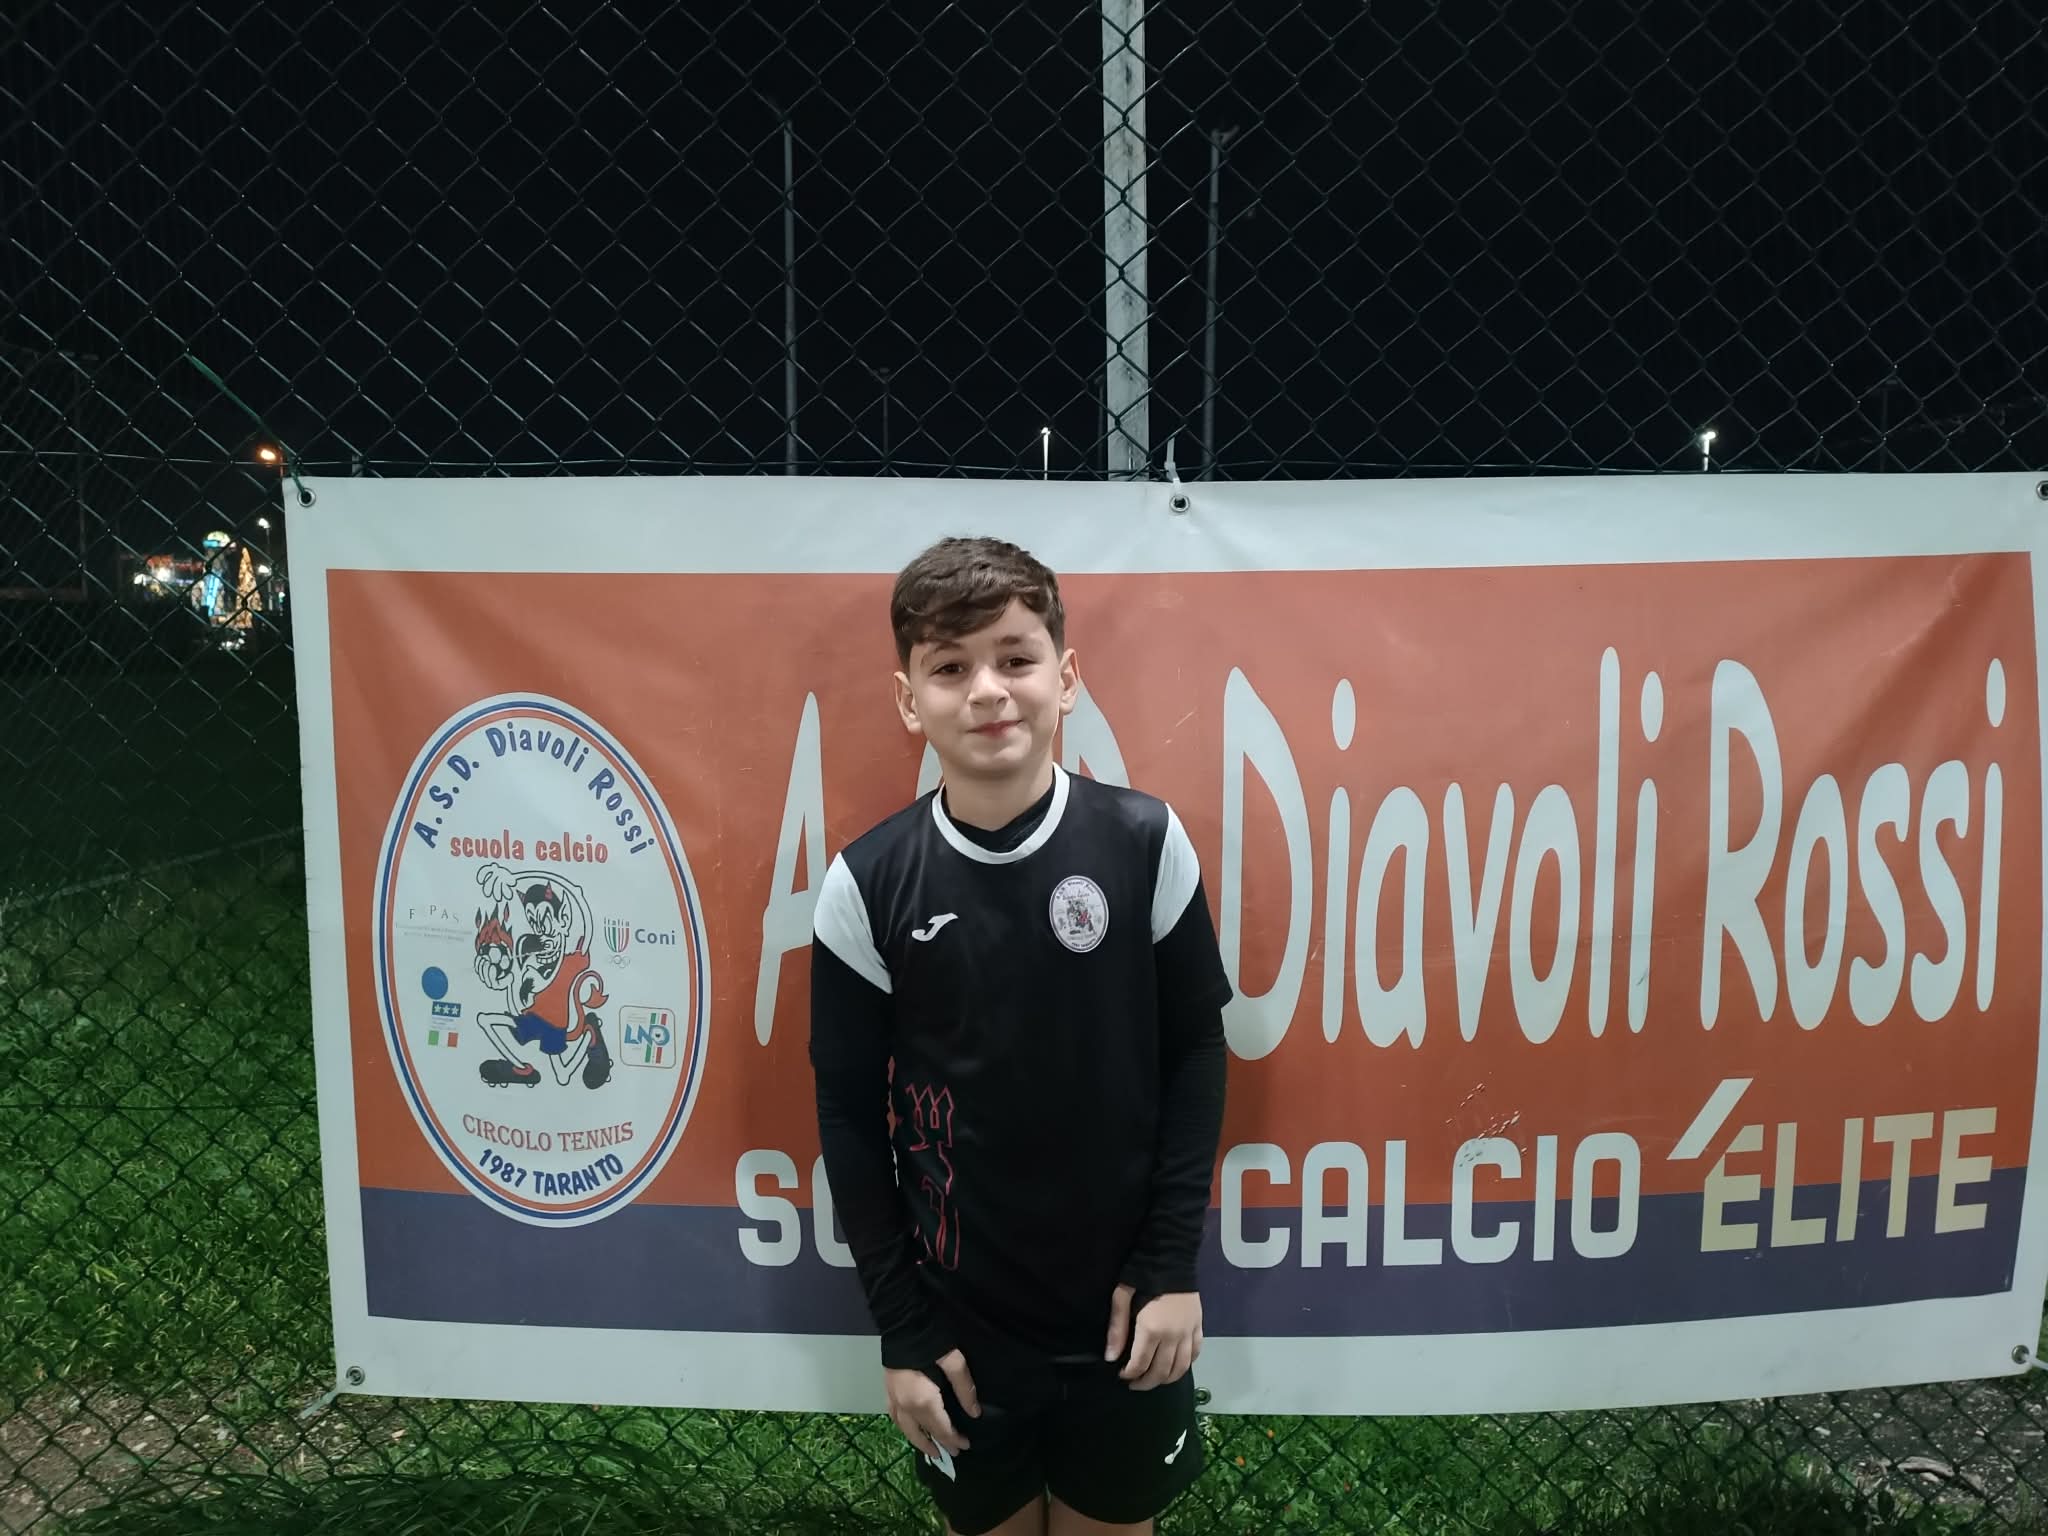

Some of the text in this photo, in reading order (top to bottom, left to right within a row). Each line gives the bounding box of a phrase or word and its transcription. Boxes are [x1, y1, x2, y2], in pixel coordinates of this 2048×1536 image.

[485, 721, 589, 773] Diavoli
[588, 768, 655, 854] Rossi
[450, 829, 609, 864] scuola calcio
[1219, 646, 1664, 1061] Diavoli
[1700, 657, 2007, 1032] Rossi
[634, 928, 676, 946] Coni
[462, 1113, 634, 1152] CIRCOLO TENNIS
[479, 1148, 624, 1197] 1987 TARANTO
[1220, 1077, 1998, 1269] CALCIO ÉLITE
